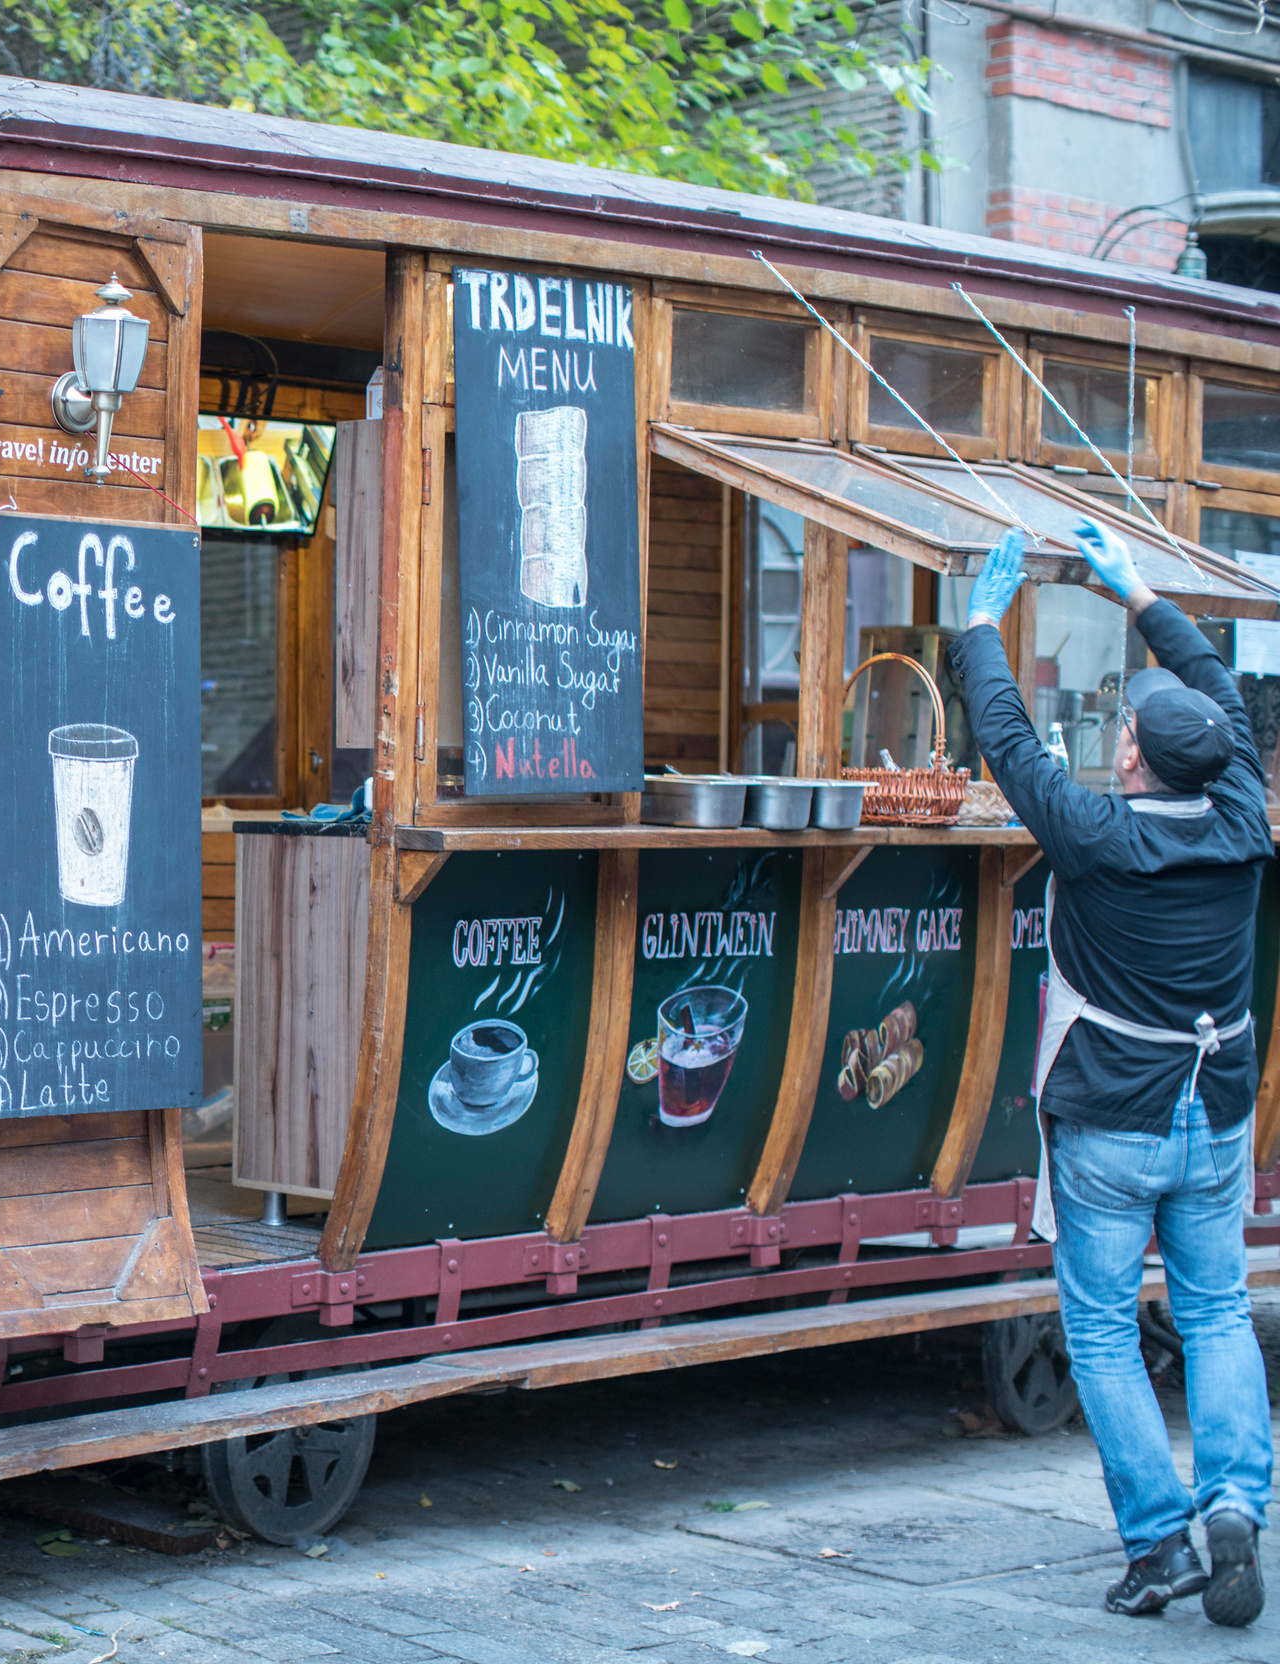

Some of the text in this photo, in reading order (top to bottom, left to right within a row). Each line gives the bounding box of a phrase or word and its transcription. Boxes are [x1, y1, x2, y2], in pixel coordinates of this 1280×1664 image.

[460, 270, 634, 350] TRDELNIK
[498, 344, 597, 392] MENU
[49, 440, 89, 472] info
[94, 451, 161, 475] enter
[8, 530, 176, 640] Coffee
[485, 610, 578, 645] Cinnamon
[586, 609, 637, 673] Sugar
[483, 644, 549, 687] Vanilla
[557, 651, 620, 710] Sugar
[486, 693, 581, 735] Coconut
[495, 736, 597, 779] Nutella
[18, 910, 190, 957] Americano
[452, 916, 543, 968] COFFEE
[16, 974, 165, 1027] Espresso
[19, 1062, 110, 1111] Latte
